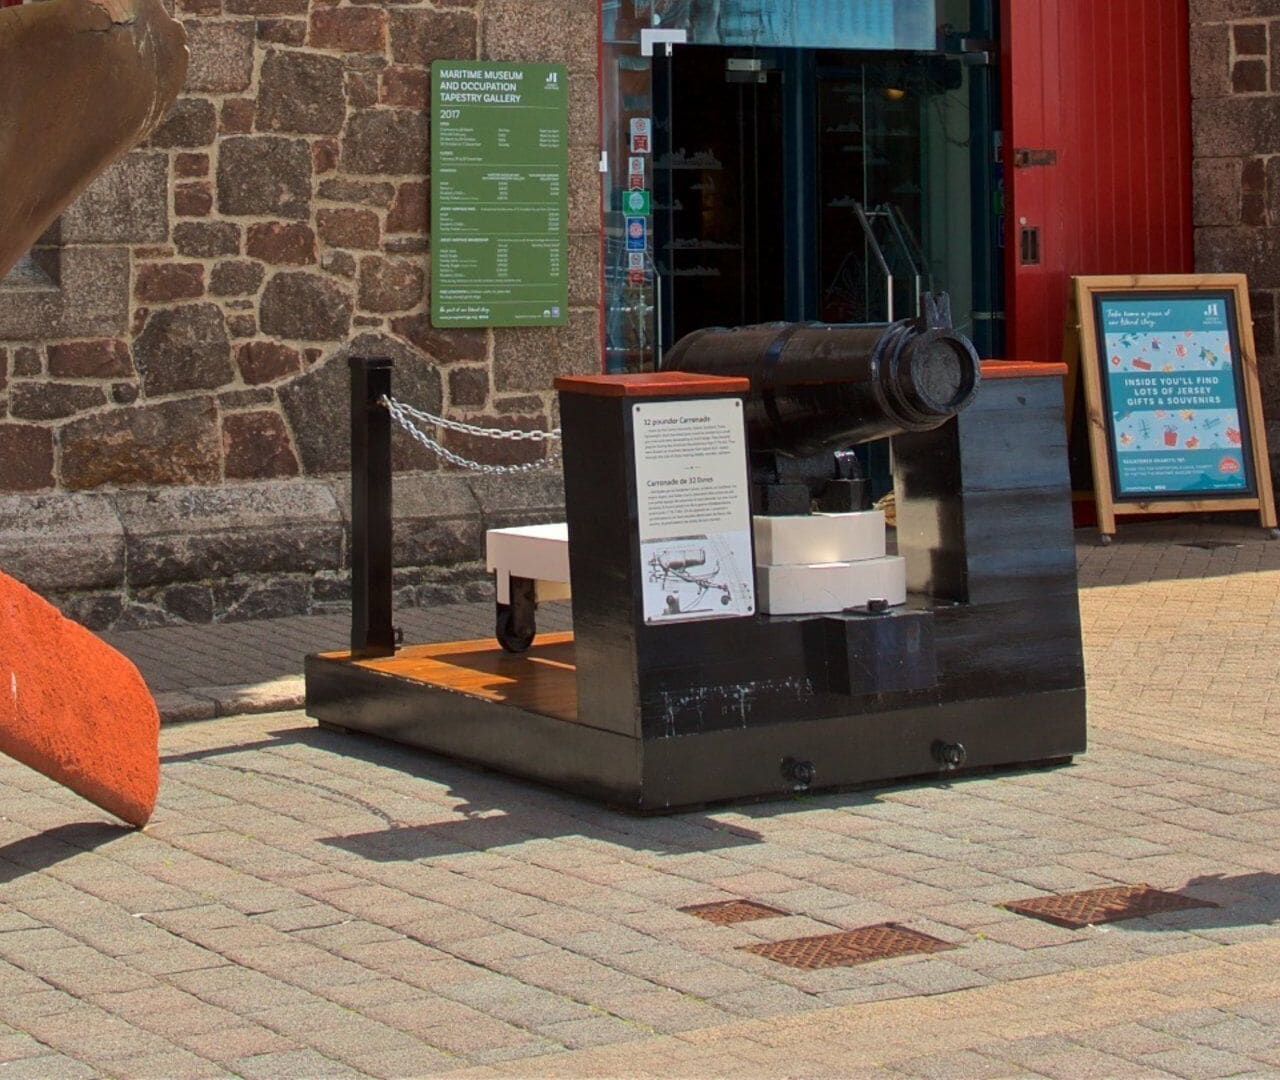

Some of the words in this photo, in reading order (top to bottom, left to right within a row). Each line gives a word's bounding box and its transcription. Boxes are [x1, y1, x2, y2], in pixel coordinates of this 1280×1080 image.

[439, 69, 482, 79] MARITIME
[484, 71, 523, 80] MUSEUM
[439, 82, 459, 90] AND
[461, 82, 517, 91] OCCUPATION
[440, 92, 483, 103] TAPESTRY
[483, 94, 521, 103] GALLERY
[439, 109, 460, 119] 2017
[1125, 378, 1157, 386] INSIDE
[1160, 377, 1194, 386] YOU'LL
[1196, 376, 1219, 385] FIND
[1134, 387, 1158, 396] LOTS
[1161, 387, 1173, 395] OF
[1177, 387, 1212, 395] JERSEY
[1127, 397, 1155, 406] GIFTS
[1158, 397, 1164, 405] &
[1167, 396, 1221, 405] SOUVENIRS
[652, 417, 678, 426] pounder
[679, 416, 711, 424] Carronade
[646, 478, 678, 487] Carronade
